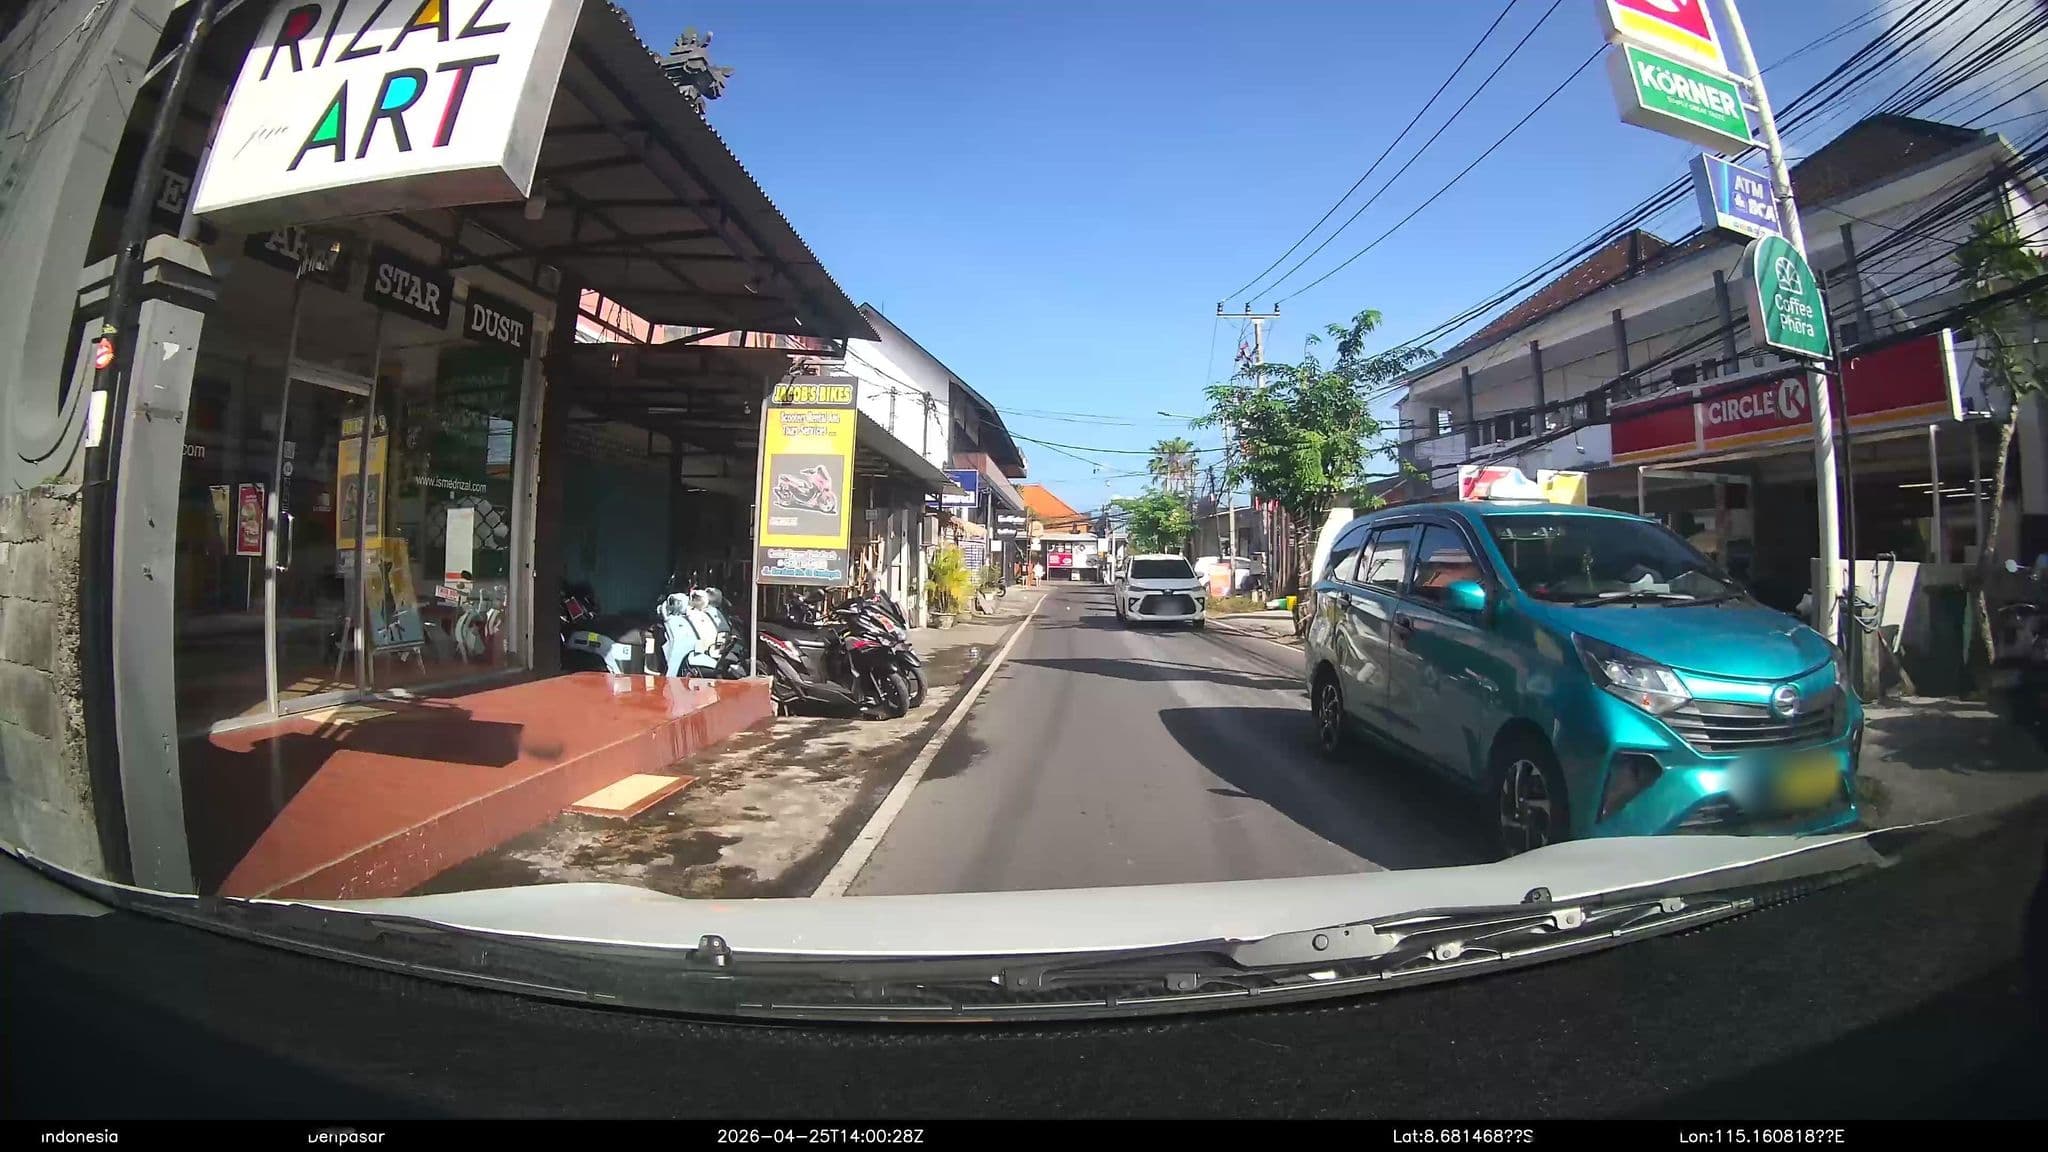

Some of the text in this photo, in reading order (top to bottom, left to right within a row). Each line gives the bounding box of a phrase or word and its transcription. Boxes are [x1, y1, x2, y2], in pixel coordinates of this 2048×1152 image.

[1637, 61, 1740, 119] KÖRNER
[286, 54, 500, 171] ART
[1734, 175, 1763, 199] ATM
[1748, 198, 1777, 222] BCA
[375, 264, 440, 315] STAR
[1775, 294, 1813, 318] Coffee
[471, 303, 523, 347] DUST
[818, 385, 853, 404] BIKES
[1708, 378, 1805, 424] CIRCLE K
